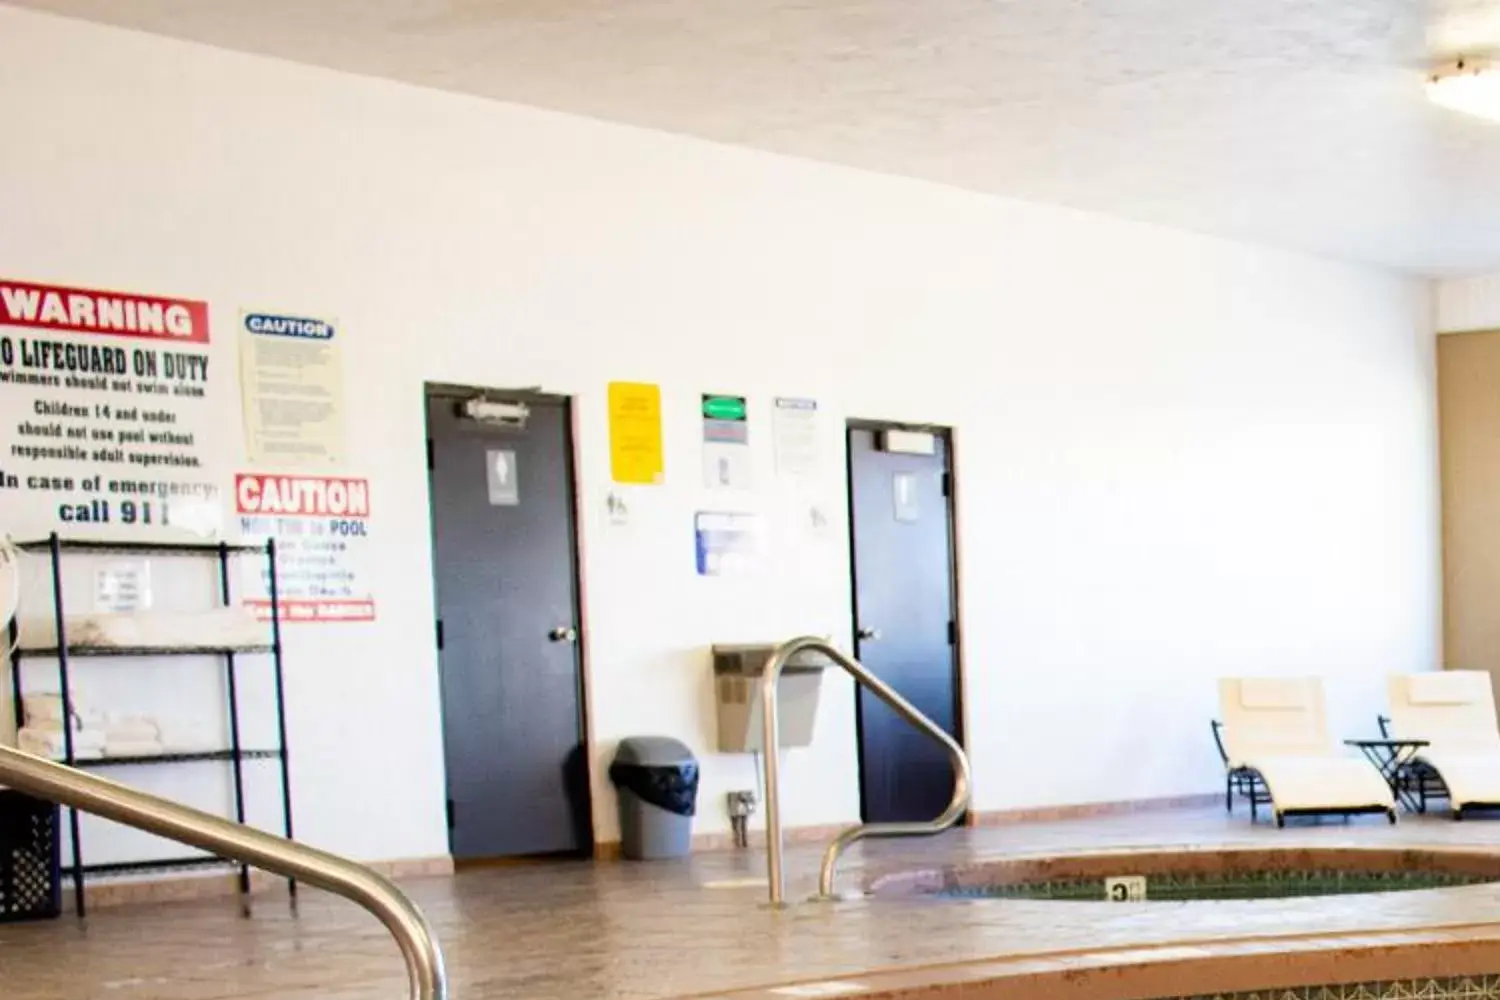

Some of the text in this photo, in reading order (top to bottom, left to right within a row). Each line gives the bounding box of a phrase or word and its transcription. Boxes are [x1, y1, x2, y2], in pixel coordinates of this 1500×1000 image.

[0, 286, 193, 337] WARNING
[249, 317, 329, 337] CAUTION
[0, 336, 209, 382] O LIFEGUARD ON DUTY
[0, 370, 60, 386] wimmers
[65, 373, 108, 391] should
[112, 379, 131, 393] not
[137, 381, 168, 395] swim
[34, 399, 89, 418] Children
[115, 406, 138, 421] and
[142, 407, 177, 424] under
[18, 421, 194, 446] should not use pool without
[11, 443, 87, 462] responsible
[92, 448, 124, 463] adult
[27, 476, 74, 490] case
[82, 475, 101, 491] of
[238, 477, 368, 515] CAUTION
[59, 498, 170, 526] call 911
[330, 519, 368, 537] POOL
